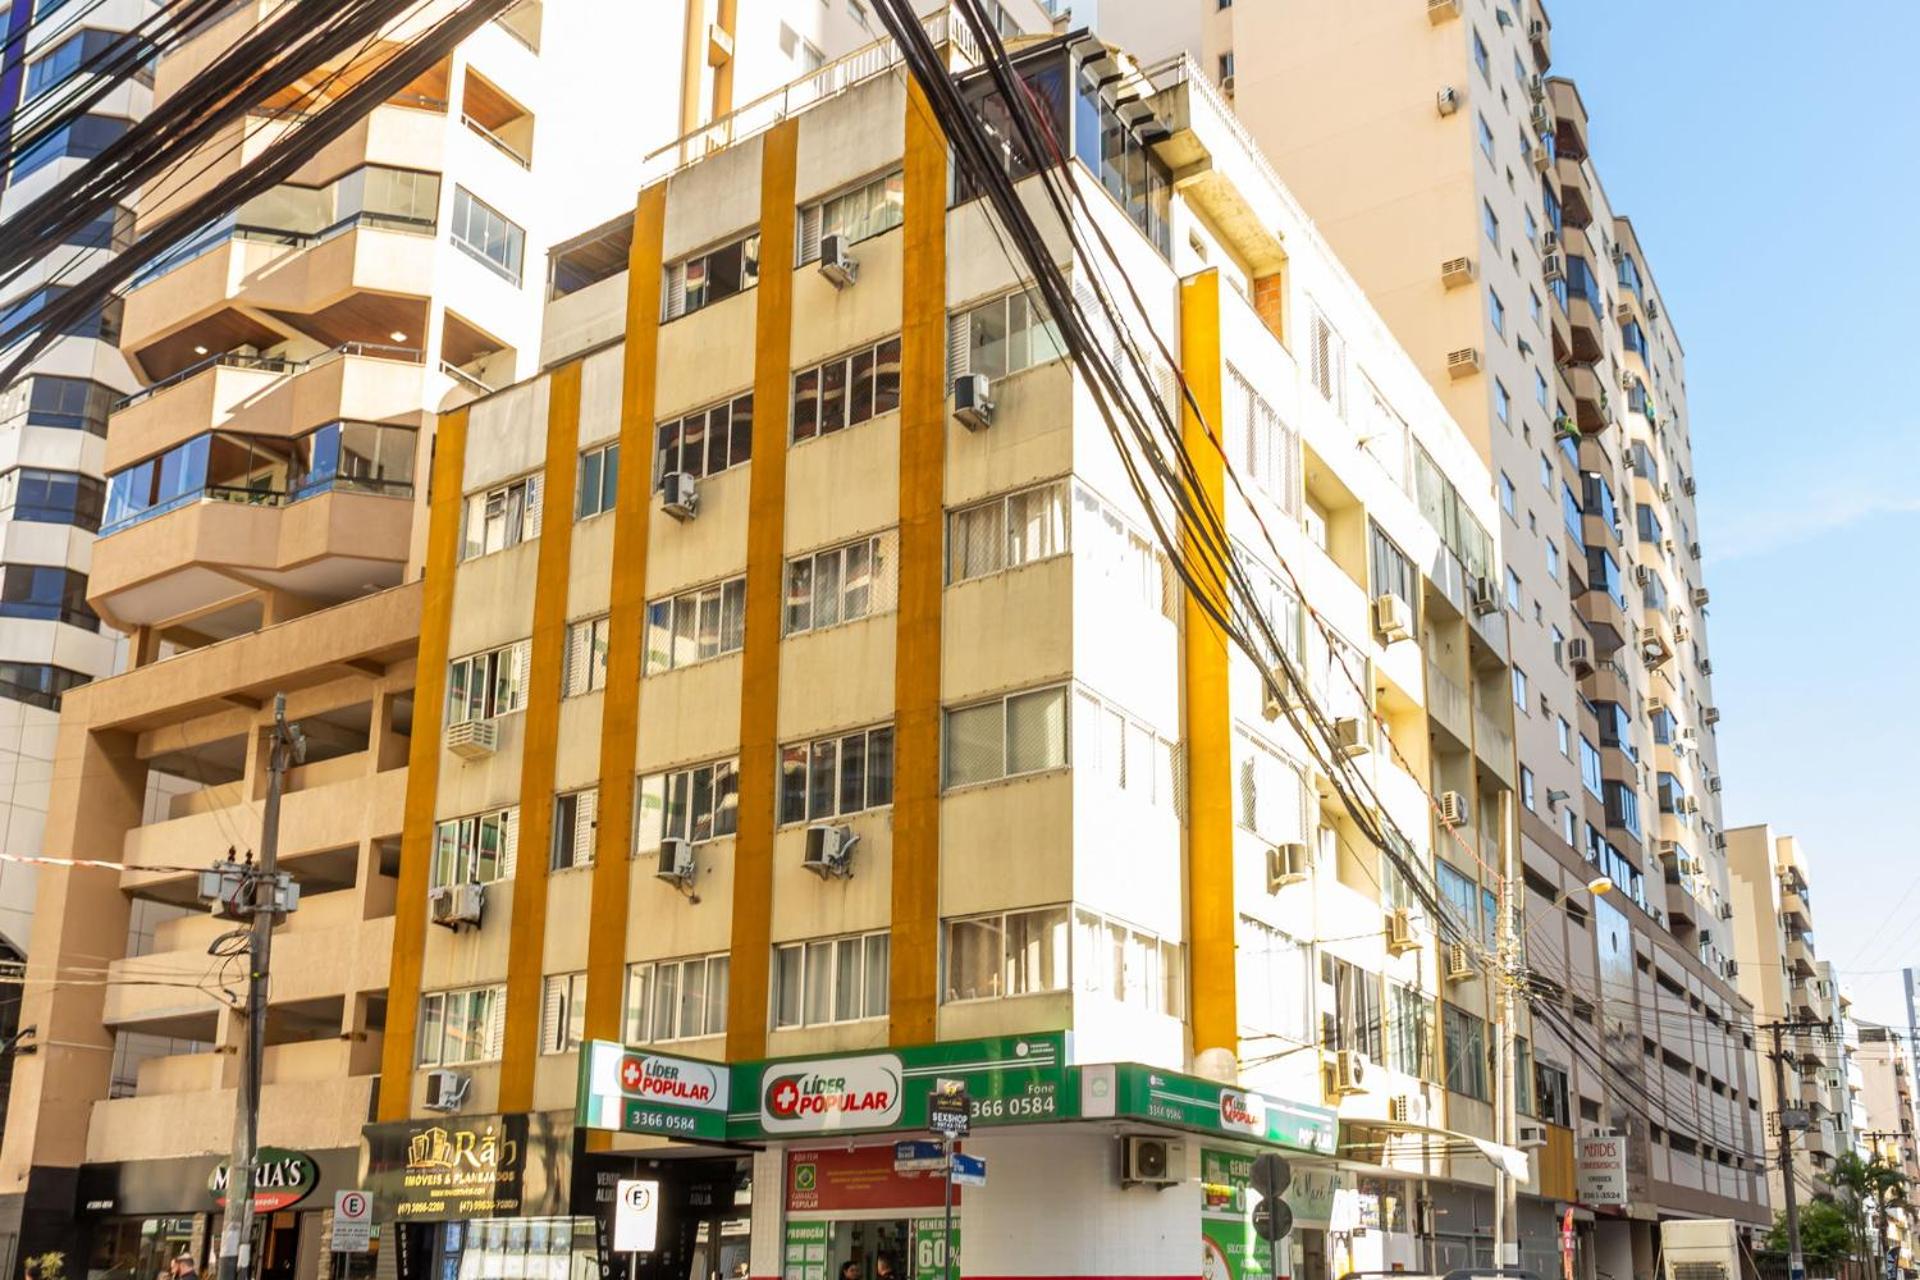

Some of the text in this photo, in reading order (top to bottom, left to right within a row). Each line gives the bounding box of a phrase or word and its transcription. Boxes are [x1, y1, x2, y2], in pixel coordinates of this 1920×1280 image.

[645, 1059, 679, 1079] LÍDER
[642, 1077, 710, 1101] POPULAR
[803, 1074, 846, 1095] LÍDER
[1027, 1084, 1055, 1095] Fone
[799, 1091, 888, 1114] POPULAR
[971, 1099, 1003, 1118] 366
[1009, 1096, 1055, 1115] 0584
[632, 1111, 696, 1131] 3366 0584
[213, 1158, 302, 1191] MIA'S
[349, 1198, 358, 1213] E
[633, 1190, 643, 1207] E
